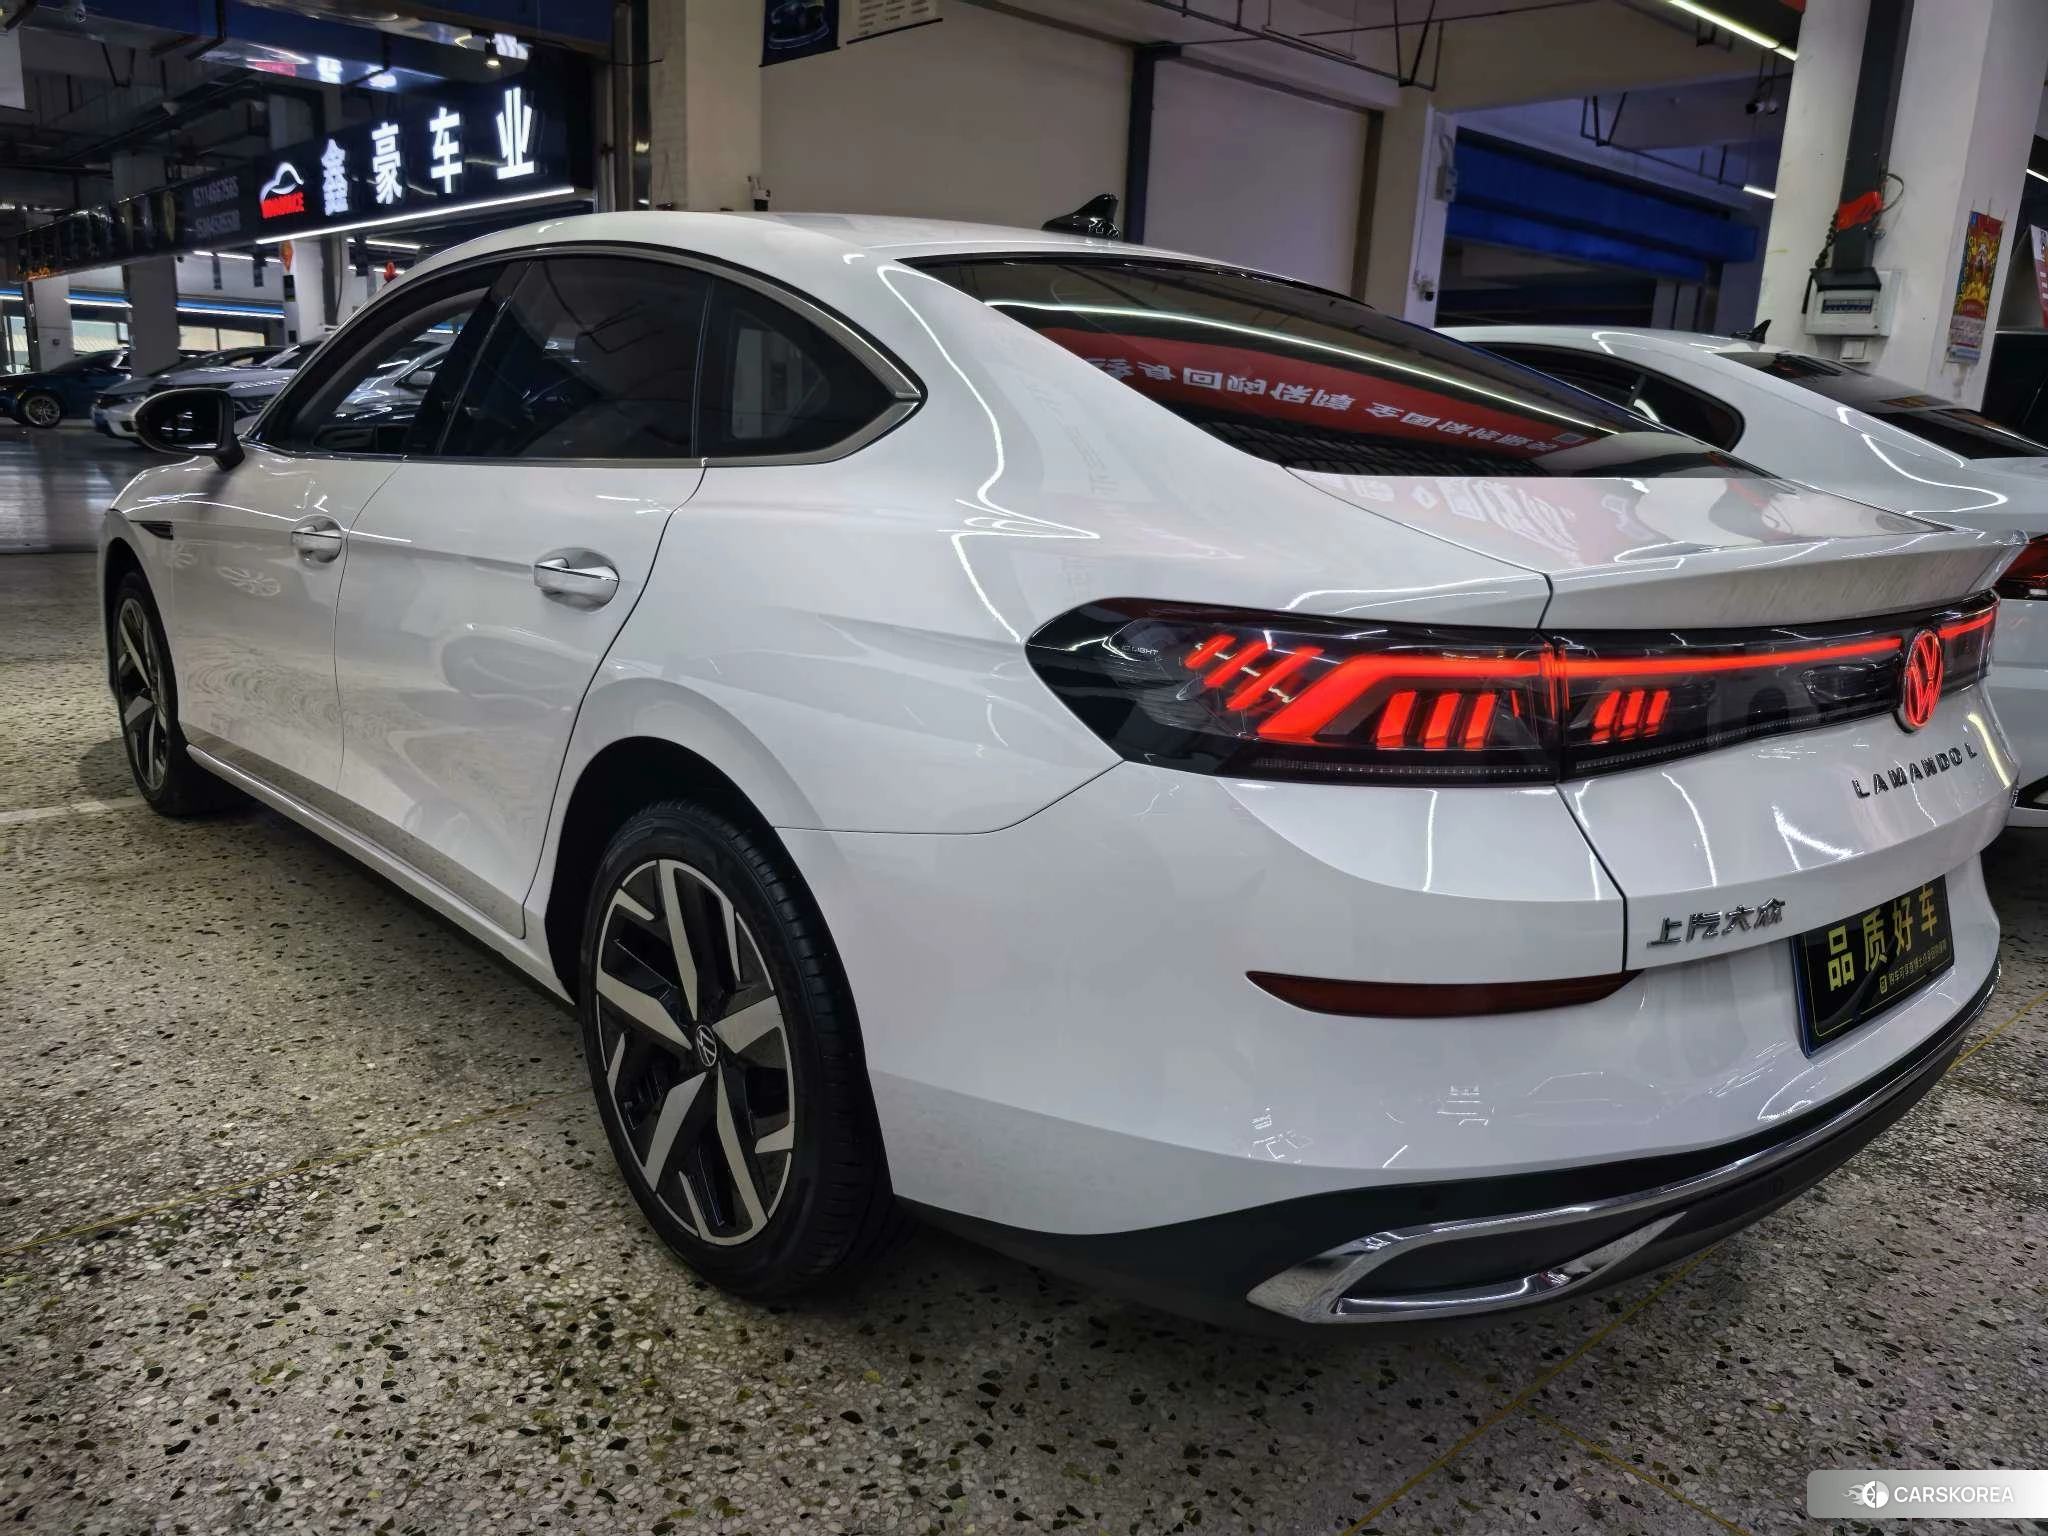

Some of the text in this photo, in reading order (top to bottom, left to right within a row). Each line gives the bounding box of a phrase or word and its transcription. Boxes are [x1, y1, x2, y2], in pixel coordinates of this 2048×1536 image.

[321, 86, 535, 217] 鑫豪车业
[1852, 742, 1978, 799] LAMANDO L
[1646, 898, 1786, 948] 上汽大众
[1828, 885, 1938, 992] 品质好车
